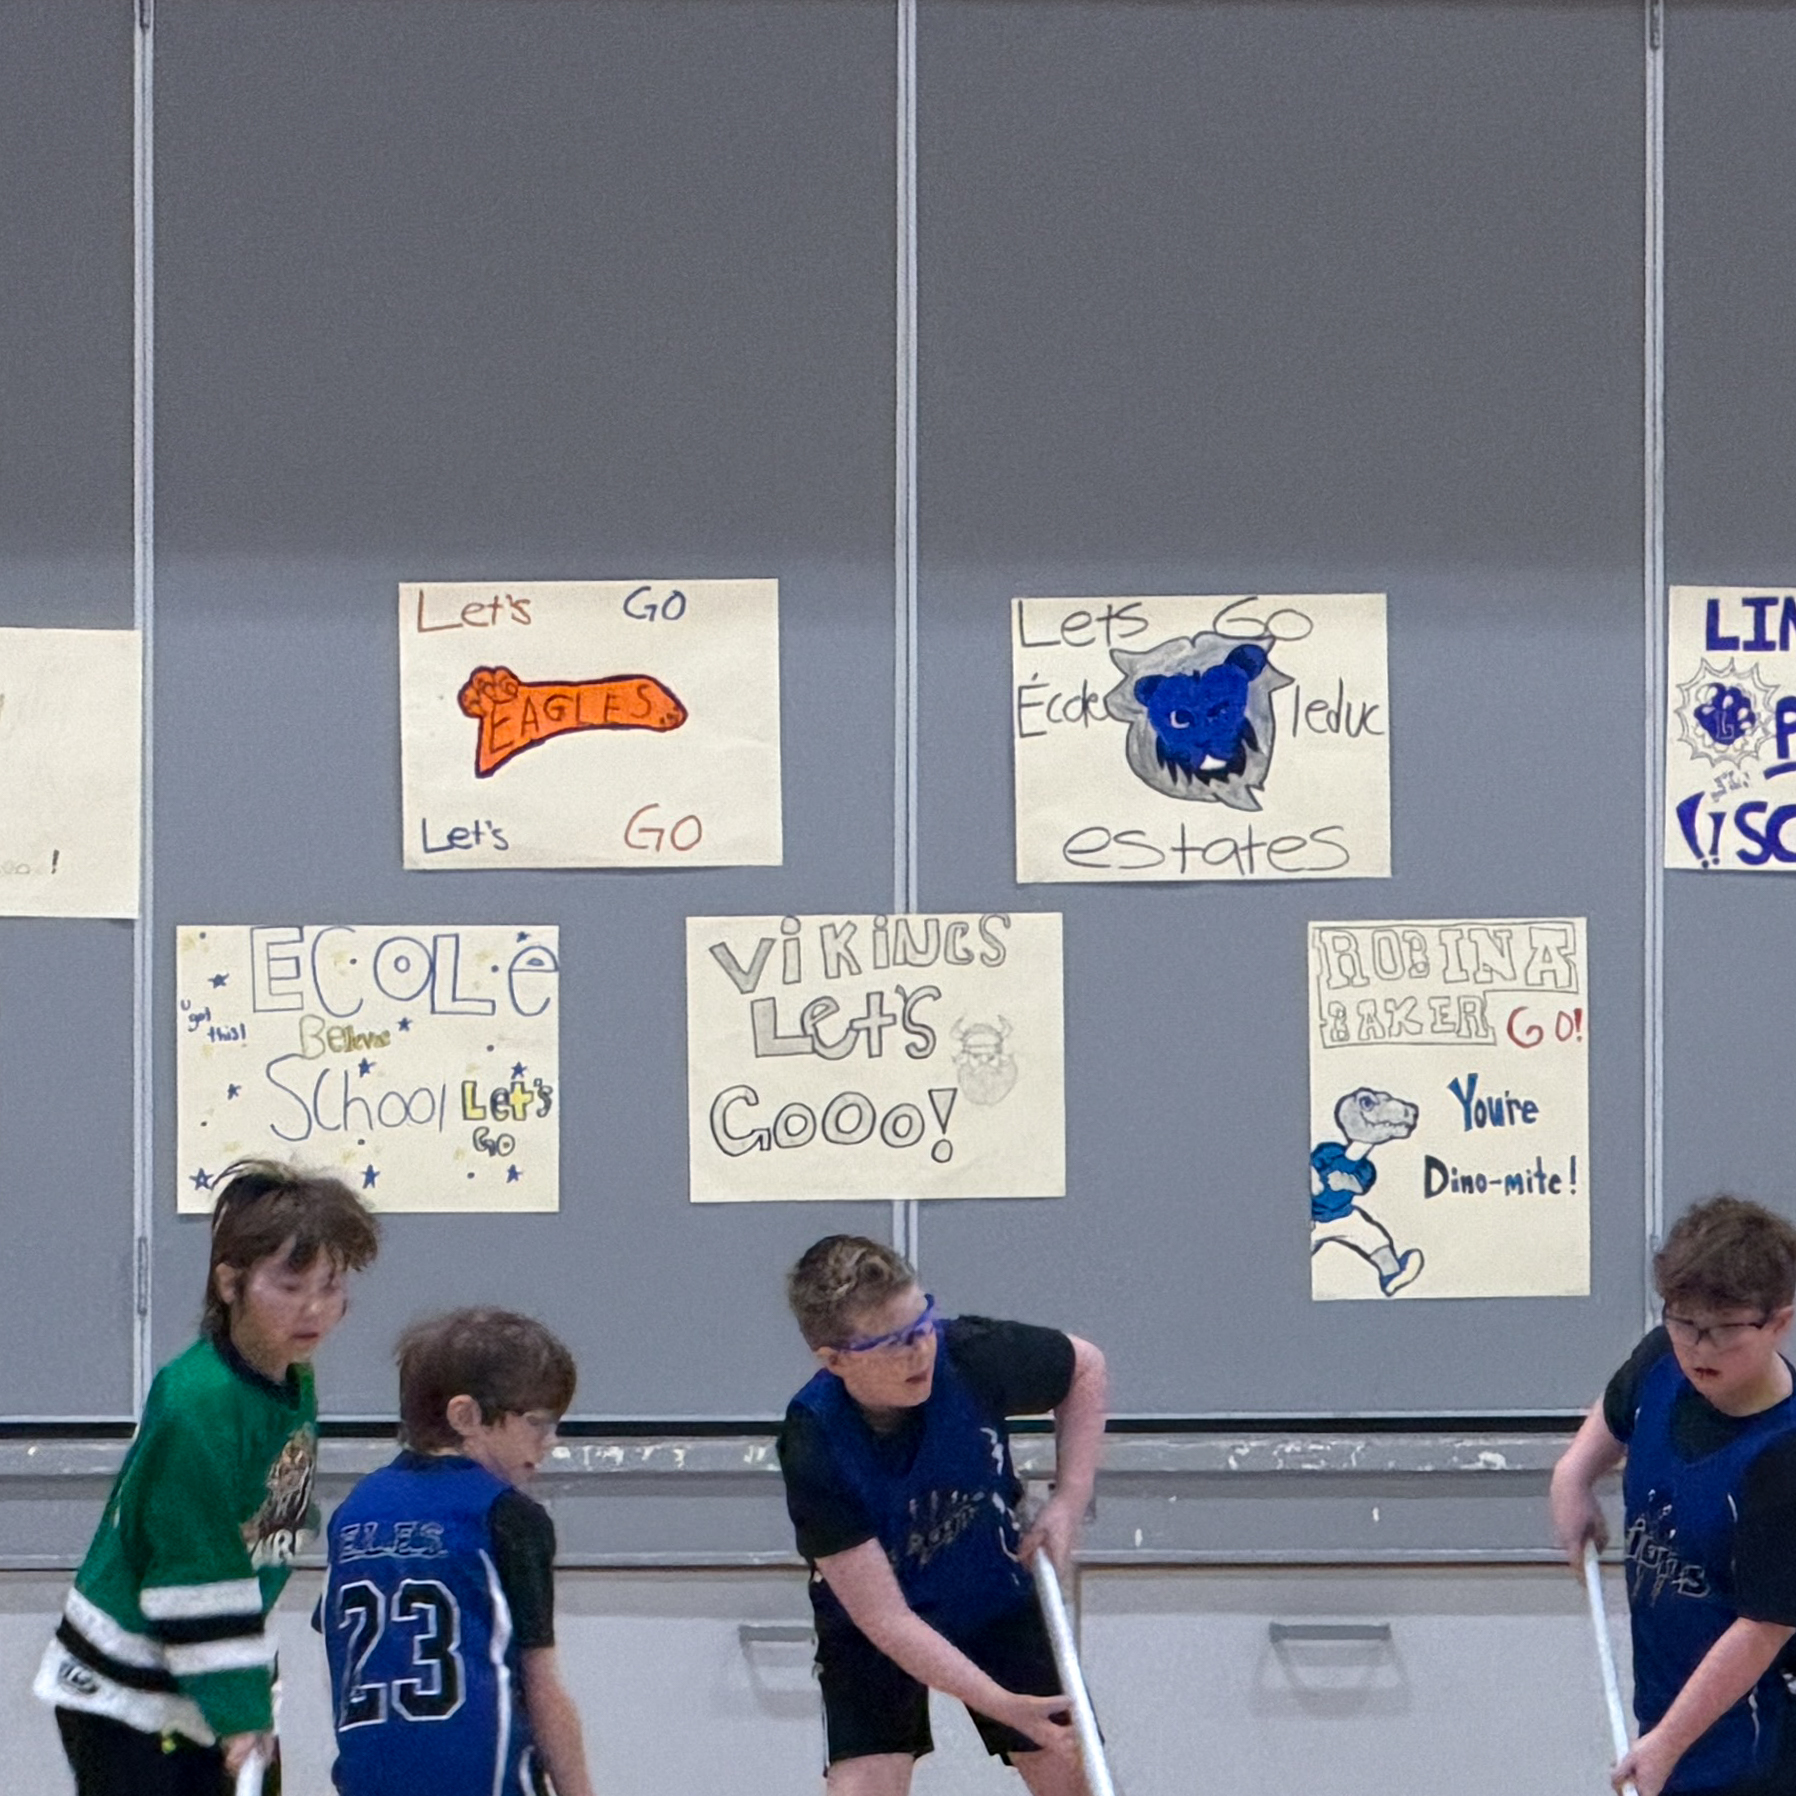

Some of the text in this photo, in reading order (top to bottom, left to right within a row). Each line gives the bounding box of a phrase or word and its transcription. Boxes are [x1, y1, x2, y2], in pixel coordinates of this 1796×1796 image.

[417, 589, 532, 633] Let's
[1018, 599, 1149, 648] Lets
[489, 684, 653, 755] EAGLES
[421, 817, 510, 855] Let's
[1319, 926, 1576, 989] ROBINA
[1326, 995, 1583, 1049] BAKER GO!
[461, 1077, 554, 1122] Let's
[1447, 1072, 1540, 1132] You're
[339, 1520, 449, 1564] ELES
[338, 1578, 467, 1733] 23
